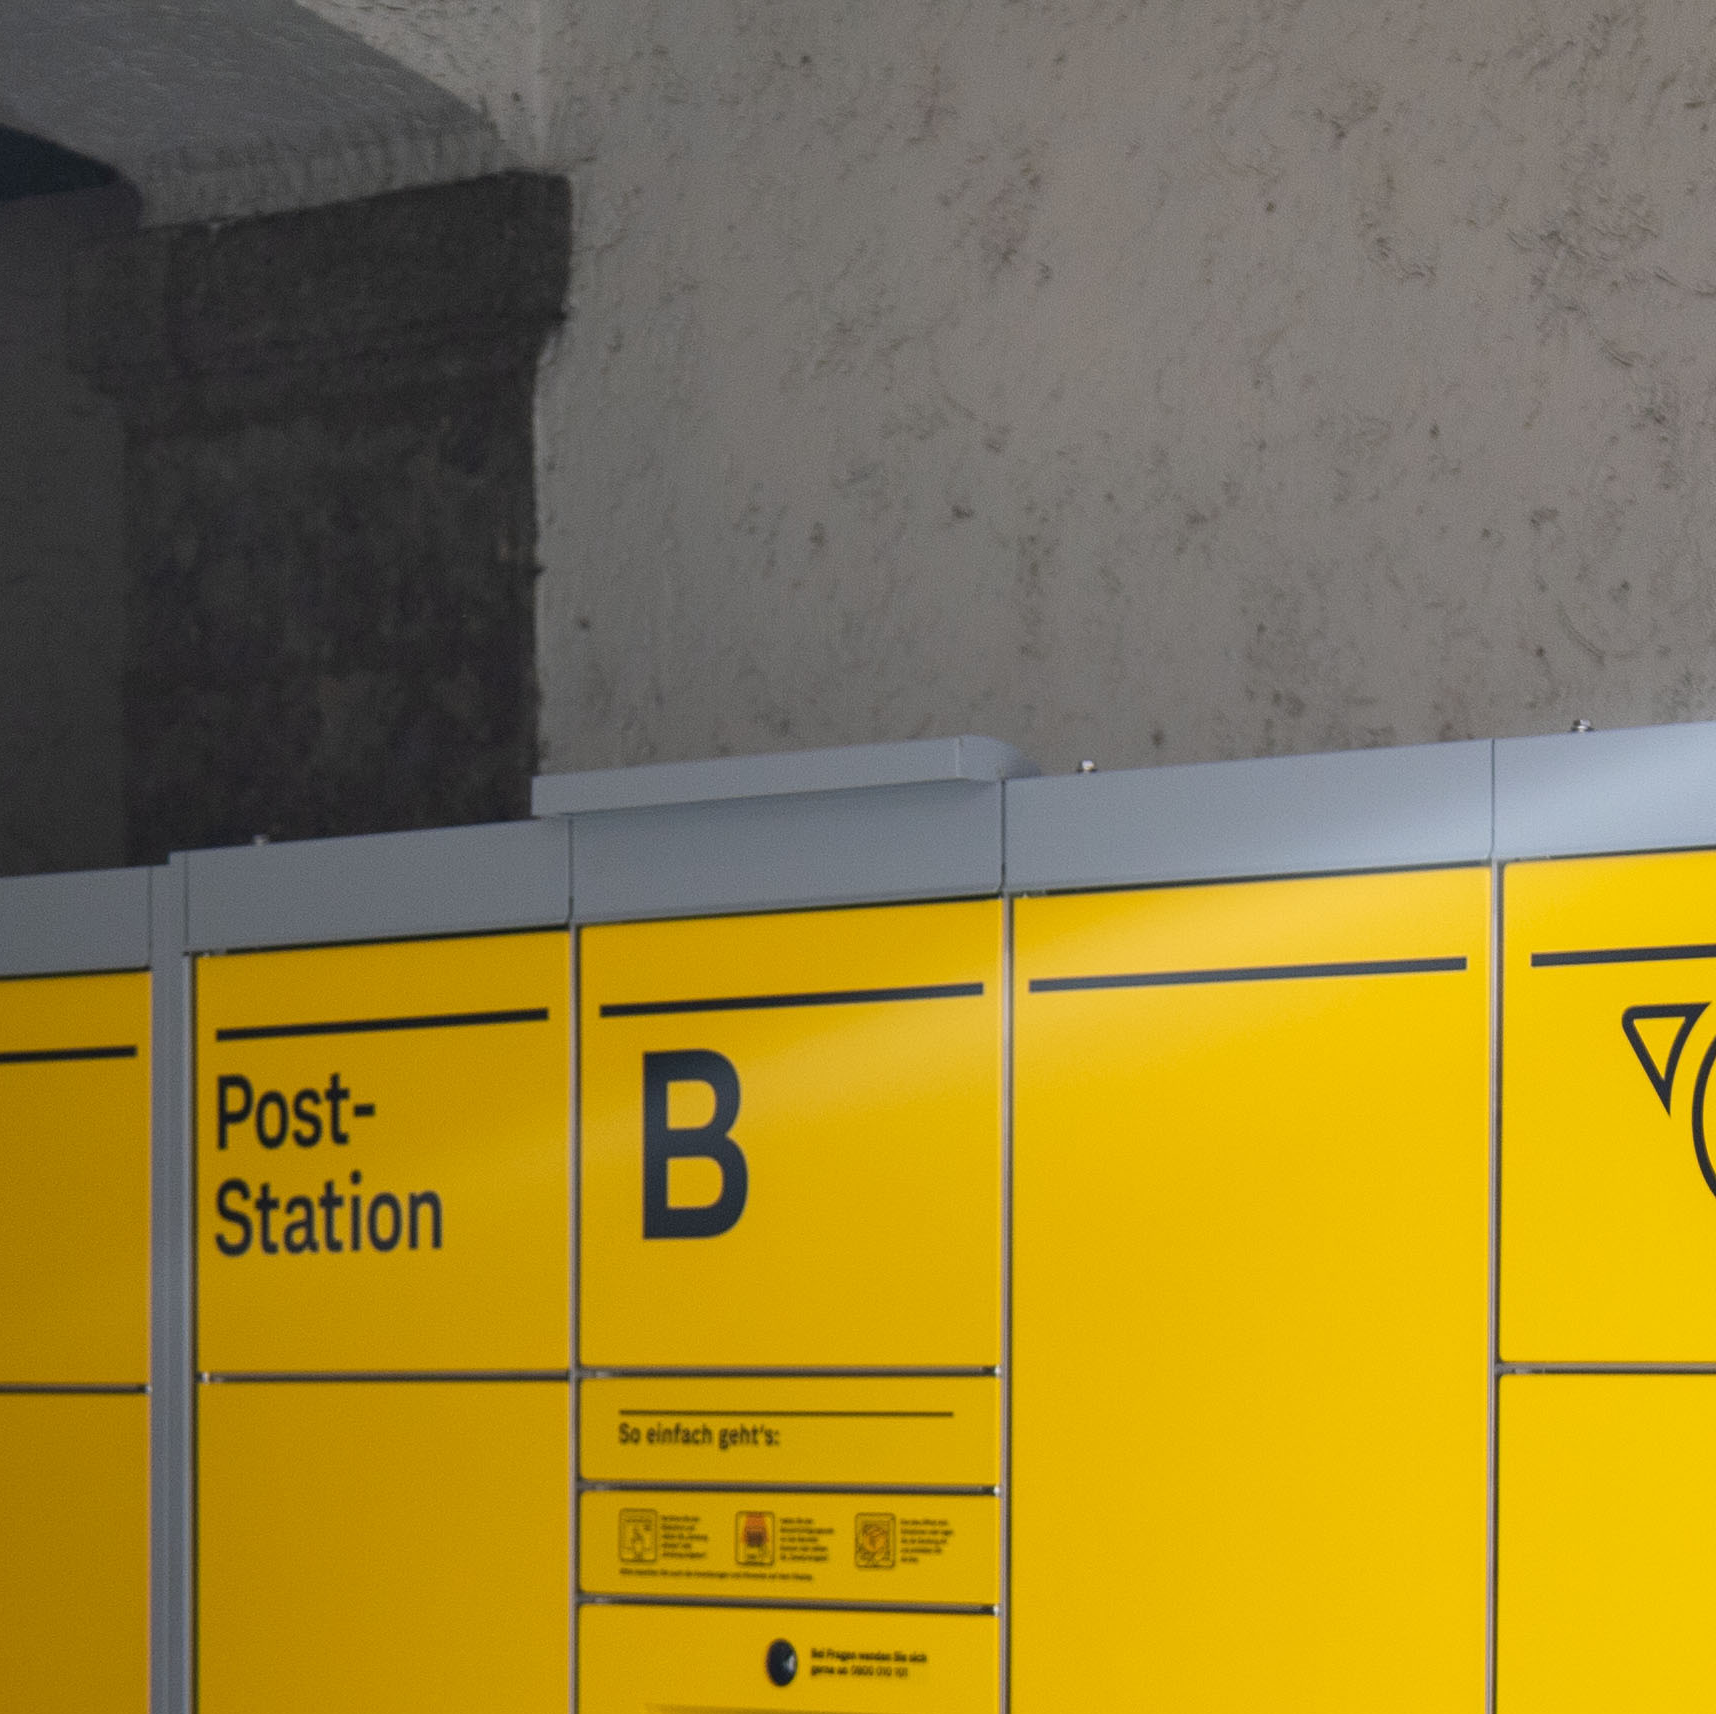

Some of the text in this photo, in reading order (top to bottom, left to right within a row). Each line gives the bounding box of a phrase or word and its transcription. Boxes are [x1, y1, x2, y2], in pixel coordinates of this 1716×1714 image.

[217, 1073, 376, 1150] Post-
[643, 1048, 749, 1240] B
[215, 1169, 443, 1257] Station
[619, 1422, 780, 1450] So einfach geht's:
